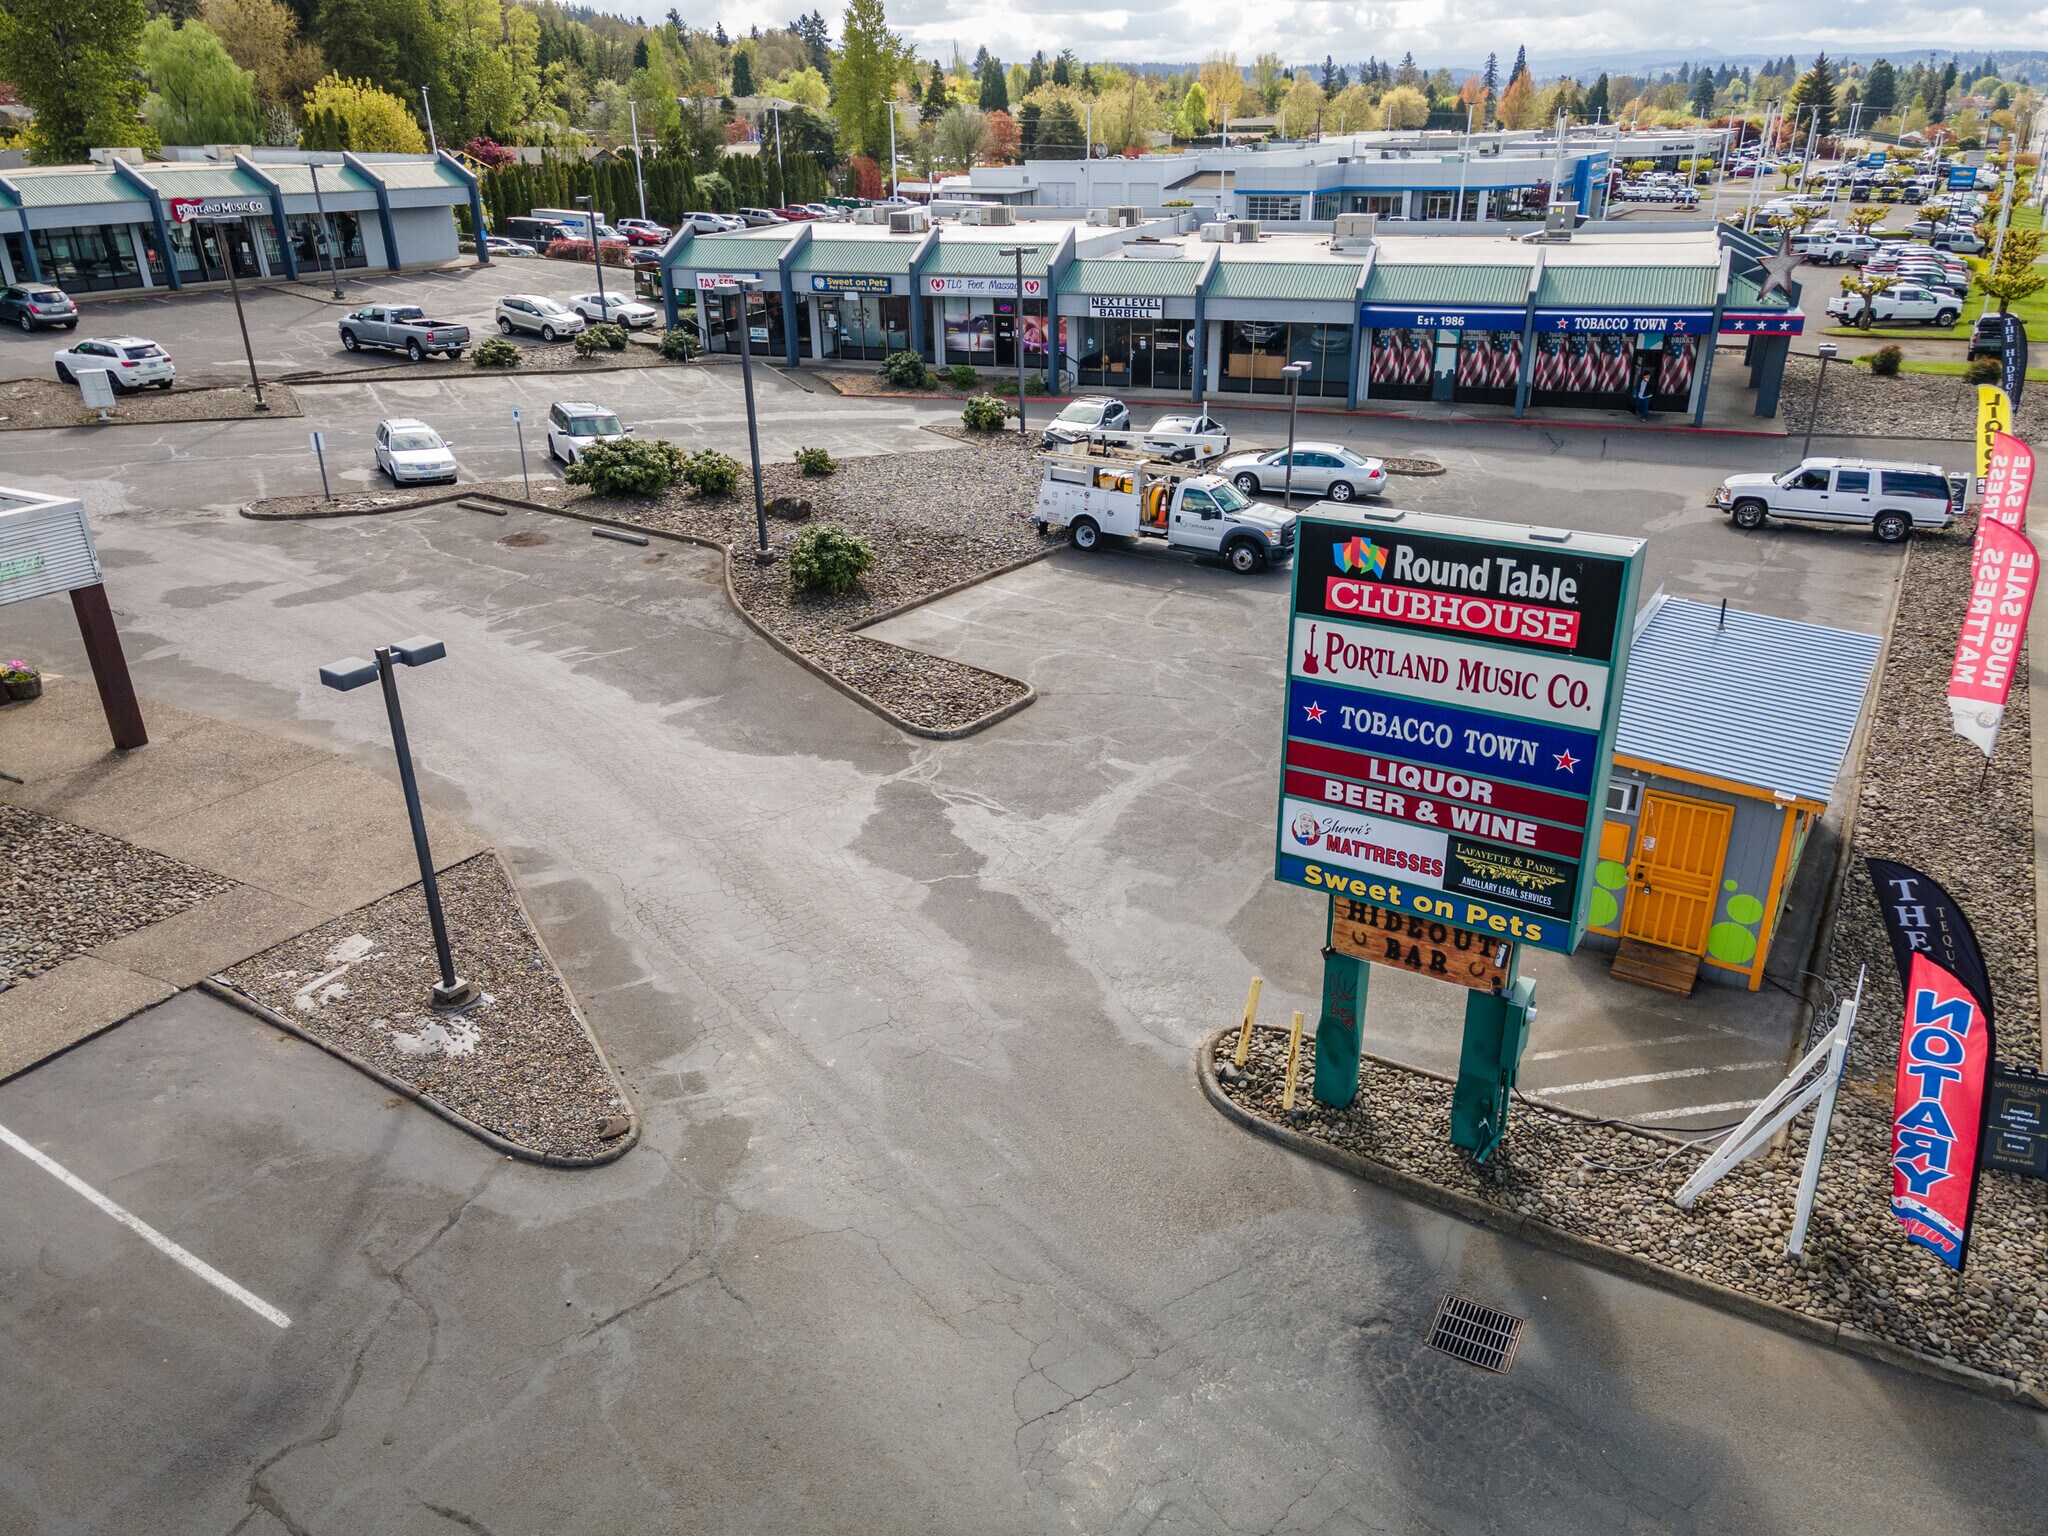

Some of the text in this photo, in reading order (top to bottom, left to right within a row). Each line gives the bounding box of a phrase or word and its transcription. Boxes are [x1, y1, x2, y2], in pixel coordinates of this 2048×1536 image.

[699, 278, 716, 289] TAX
[826, 277, 853, 286] Sweet
[869, 279, 888, 287] Pets
[946, 279, 1018, 292] TLC Foot Massag
[1091, 297, 1161, 307] NEXT LEVEL
[1099, 308, 1153, 318] BARBELL
[1417, 315, 1465, 326] Est. 1986
[1574, 317, 1668, 331] TOBACCO TOWN
[2004, 317, 2015, 343] THE
[1393, 544, 1490, 591] Round
[1331, 582, 1576, 643] CLUBHOUSE
[1324, 632, 1450, 685] PORTLAND
[1456, 658, 1539, 700] MUSIC
[1340, 706, 1539, 766] TOBACCO TOWN
[1369, 758, 1494, 804] LIQUOR
[1317, 817, 1372, 835] Sherri's
[1324, 779, 1538, 846] BEER & WINE
[1326, 834, 1444, 878] MATTRESSES
[1457, 843, 1511, 865] LAFAYETTE
[1513, 856, 1523, 867] &
[1526, 859, 1556, 876] PAINE
[1303, 864, 1543, 942] Sweet on Pets
[1461, 876, 1552, 906] ANCILLARY LEGAL SERVICES
[1347, 899, 1498, 958] HIDEOUT
[1889, 878, 1932, 951] THE
[1384, 937, 1448, 974] BAR
